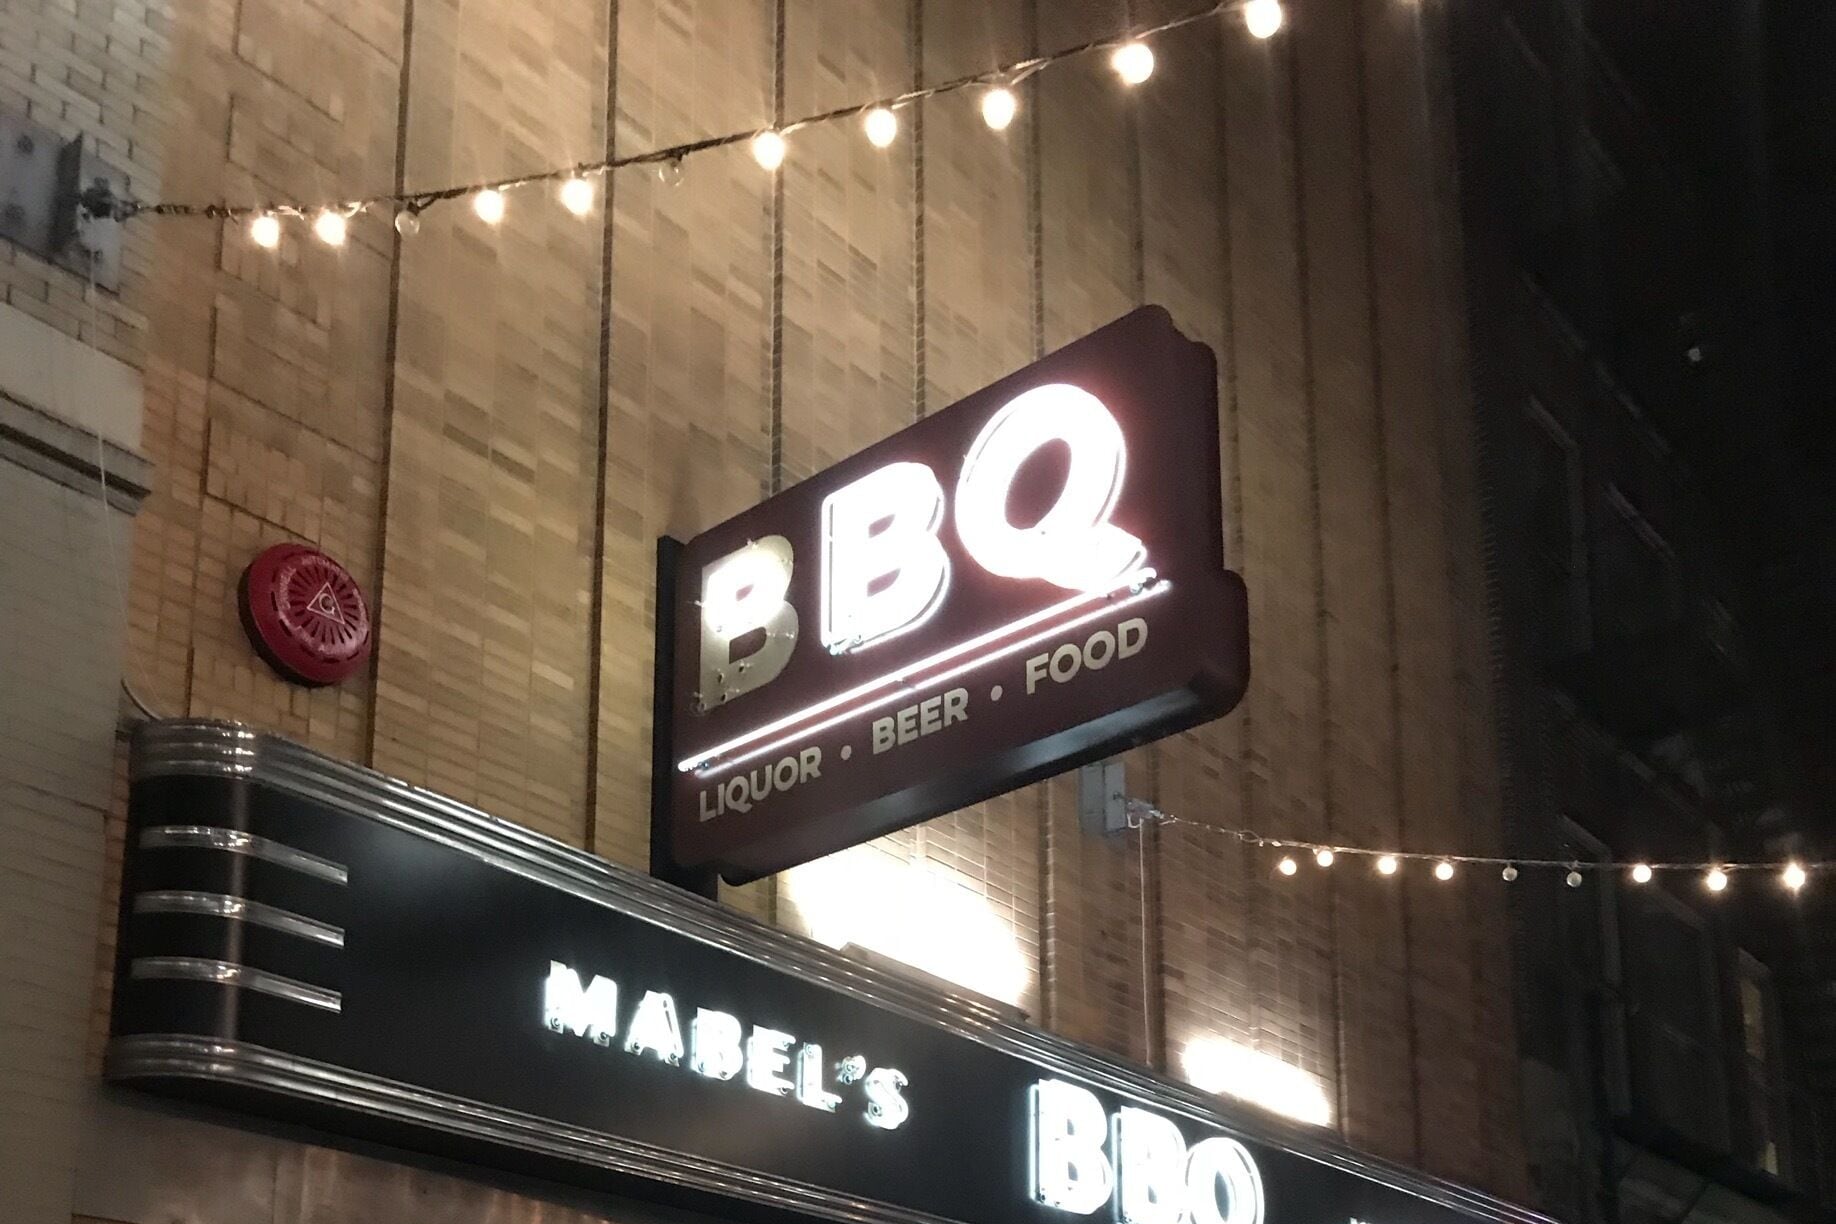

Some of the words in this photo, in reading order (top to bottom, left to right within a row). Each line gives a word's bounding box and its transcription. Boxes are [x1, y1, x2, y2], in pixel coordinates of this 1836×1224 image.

[697, 382, 1149, 716] BBQ
[699, 746, 822, 823] LIQUOR
[871, 686, 969, 756] BEER
[1025, 616, 1149, 695] FOOD
[545, 959, 910, 1131] MABEL'S
